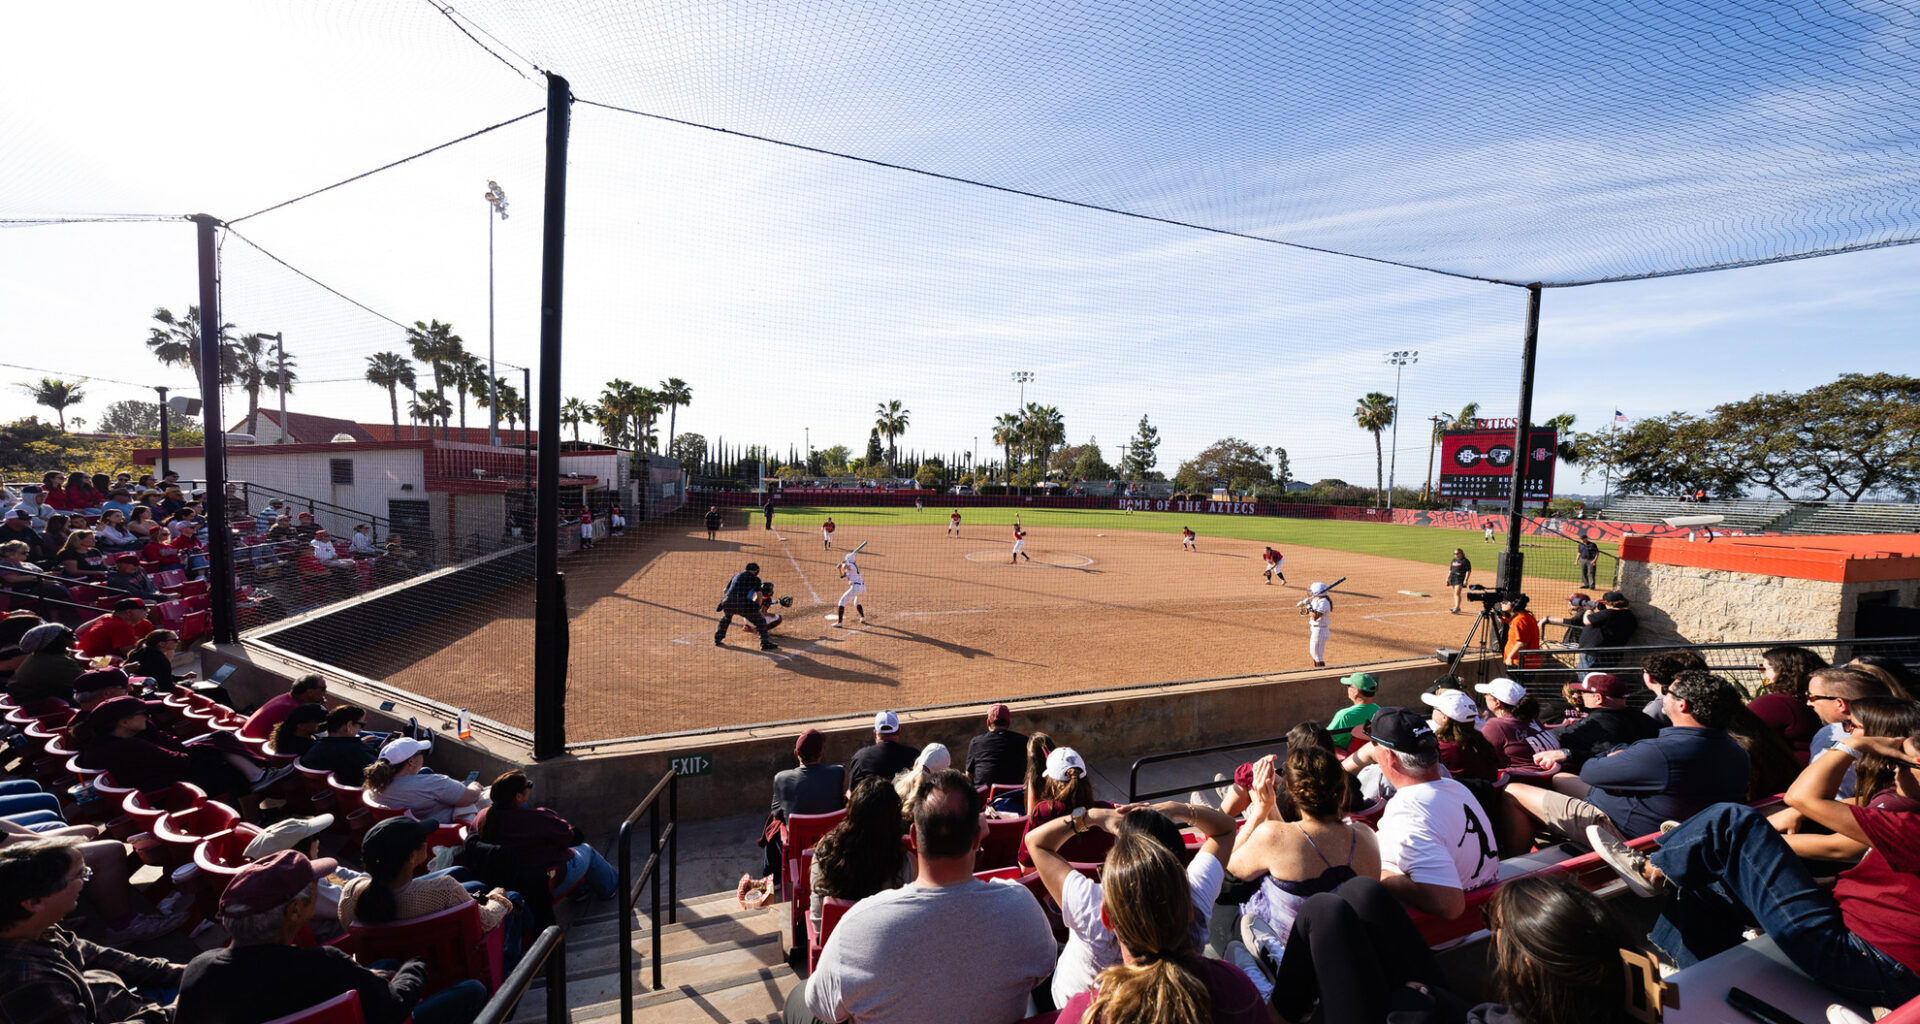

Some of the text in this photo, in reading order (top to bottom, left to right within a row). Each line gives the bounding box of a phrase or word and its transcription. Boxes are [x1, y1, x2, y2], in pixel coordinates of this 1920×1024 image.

[1475, 417, 1518, 429] AZTECS
[1156, 500, 1170, 511] OF
[1177, 501, 1200, 512] THE
[1209, 501, 1255, 514] AZTECS
[672, 756, 701, 775] EXIT
